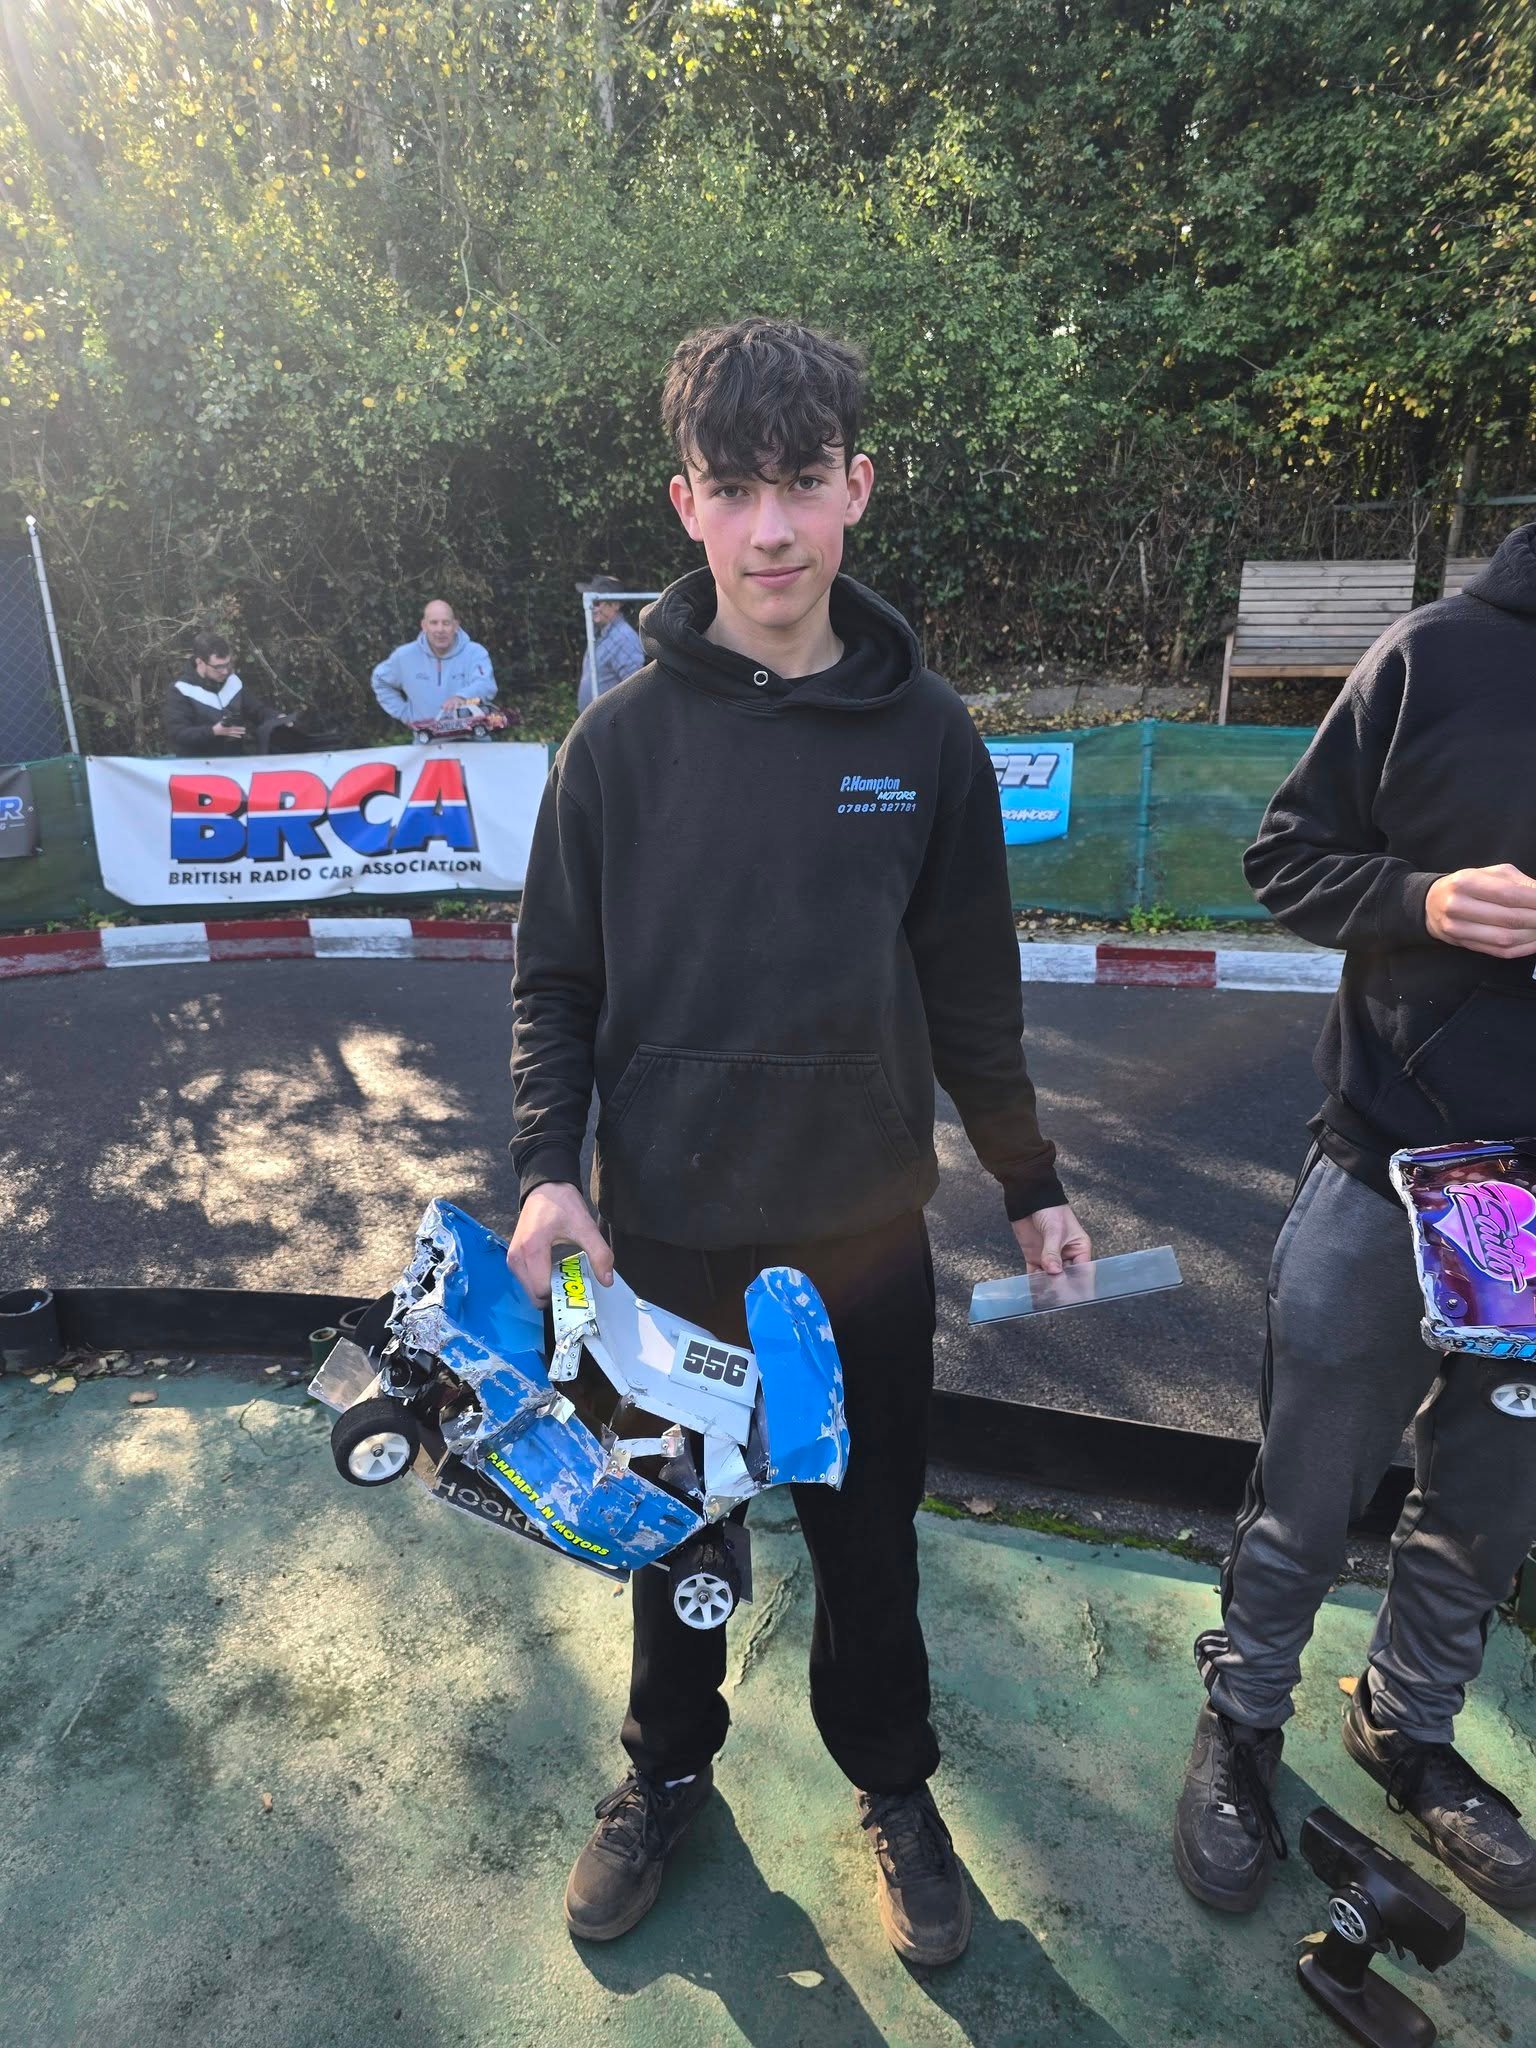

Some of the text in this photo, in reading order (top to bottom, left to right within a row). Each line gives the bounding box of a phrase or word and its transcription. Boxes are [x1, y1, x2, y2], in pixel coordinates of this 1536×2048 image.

[840, 776, 901, 794] P.Hampton
[877, 791, 917, 801] MOTORS
[169, 759, 479, 863] BRCA
[837, 803, 877, 813] 07883
[169, 860, 482, 885] BRITISH RADIO CAR ASSOCIATION
[682, 1340, 749, 1388] 556
[487, 1451, 610, 1556] P.HAMPTN MOTORS
